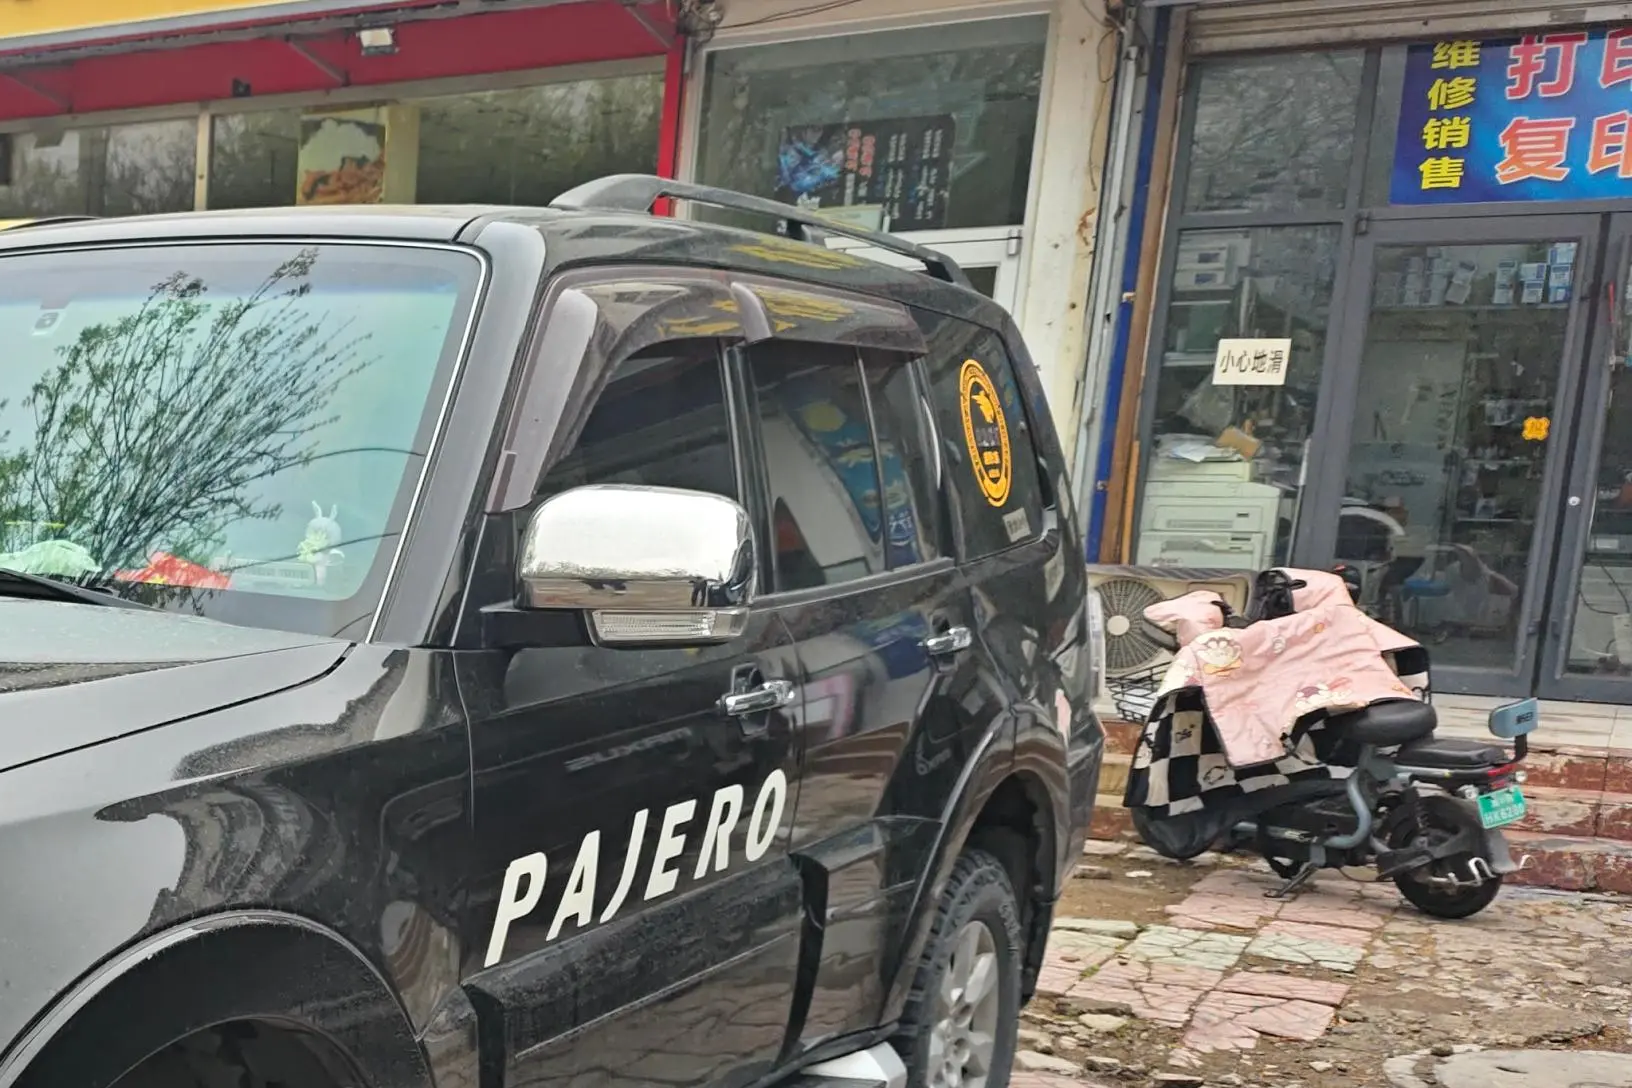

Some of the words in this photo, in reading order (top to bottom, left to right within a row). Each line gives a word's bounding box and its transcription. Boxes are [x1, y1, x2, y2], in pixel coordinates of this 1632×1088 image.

[1418, 39, 1481, 190] 维修销售
[1219, 349, 1284, 374] 小心地滑
[483, 768, 788, 969] PAJERO
